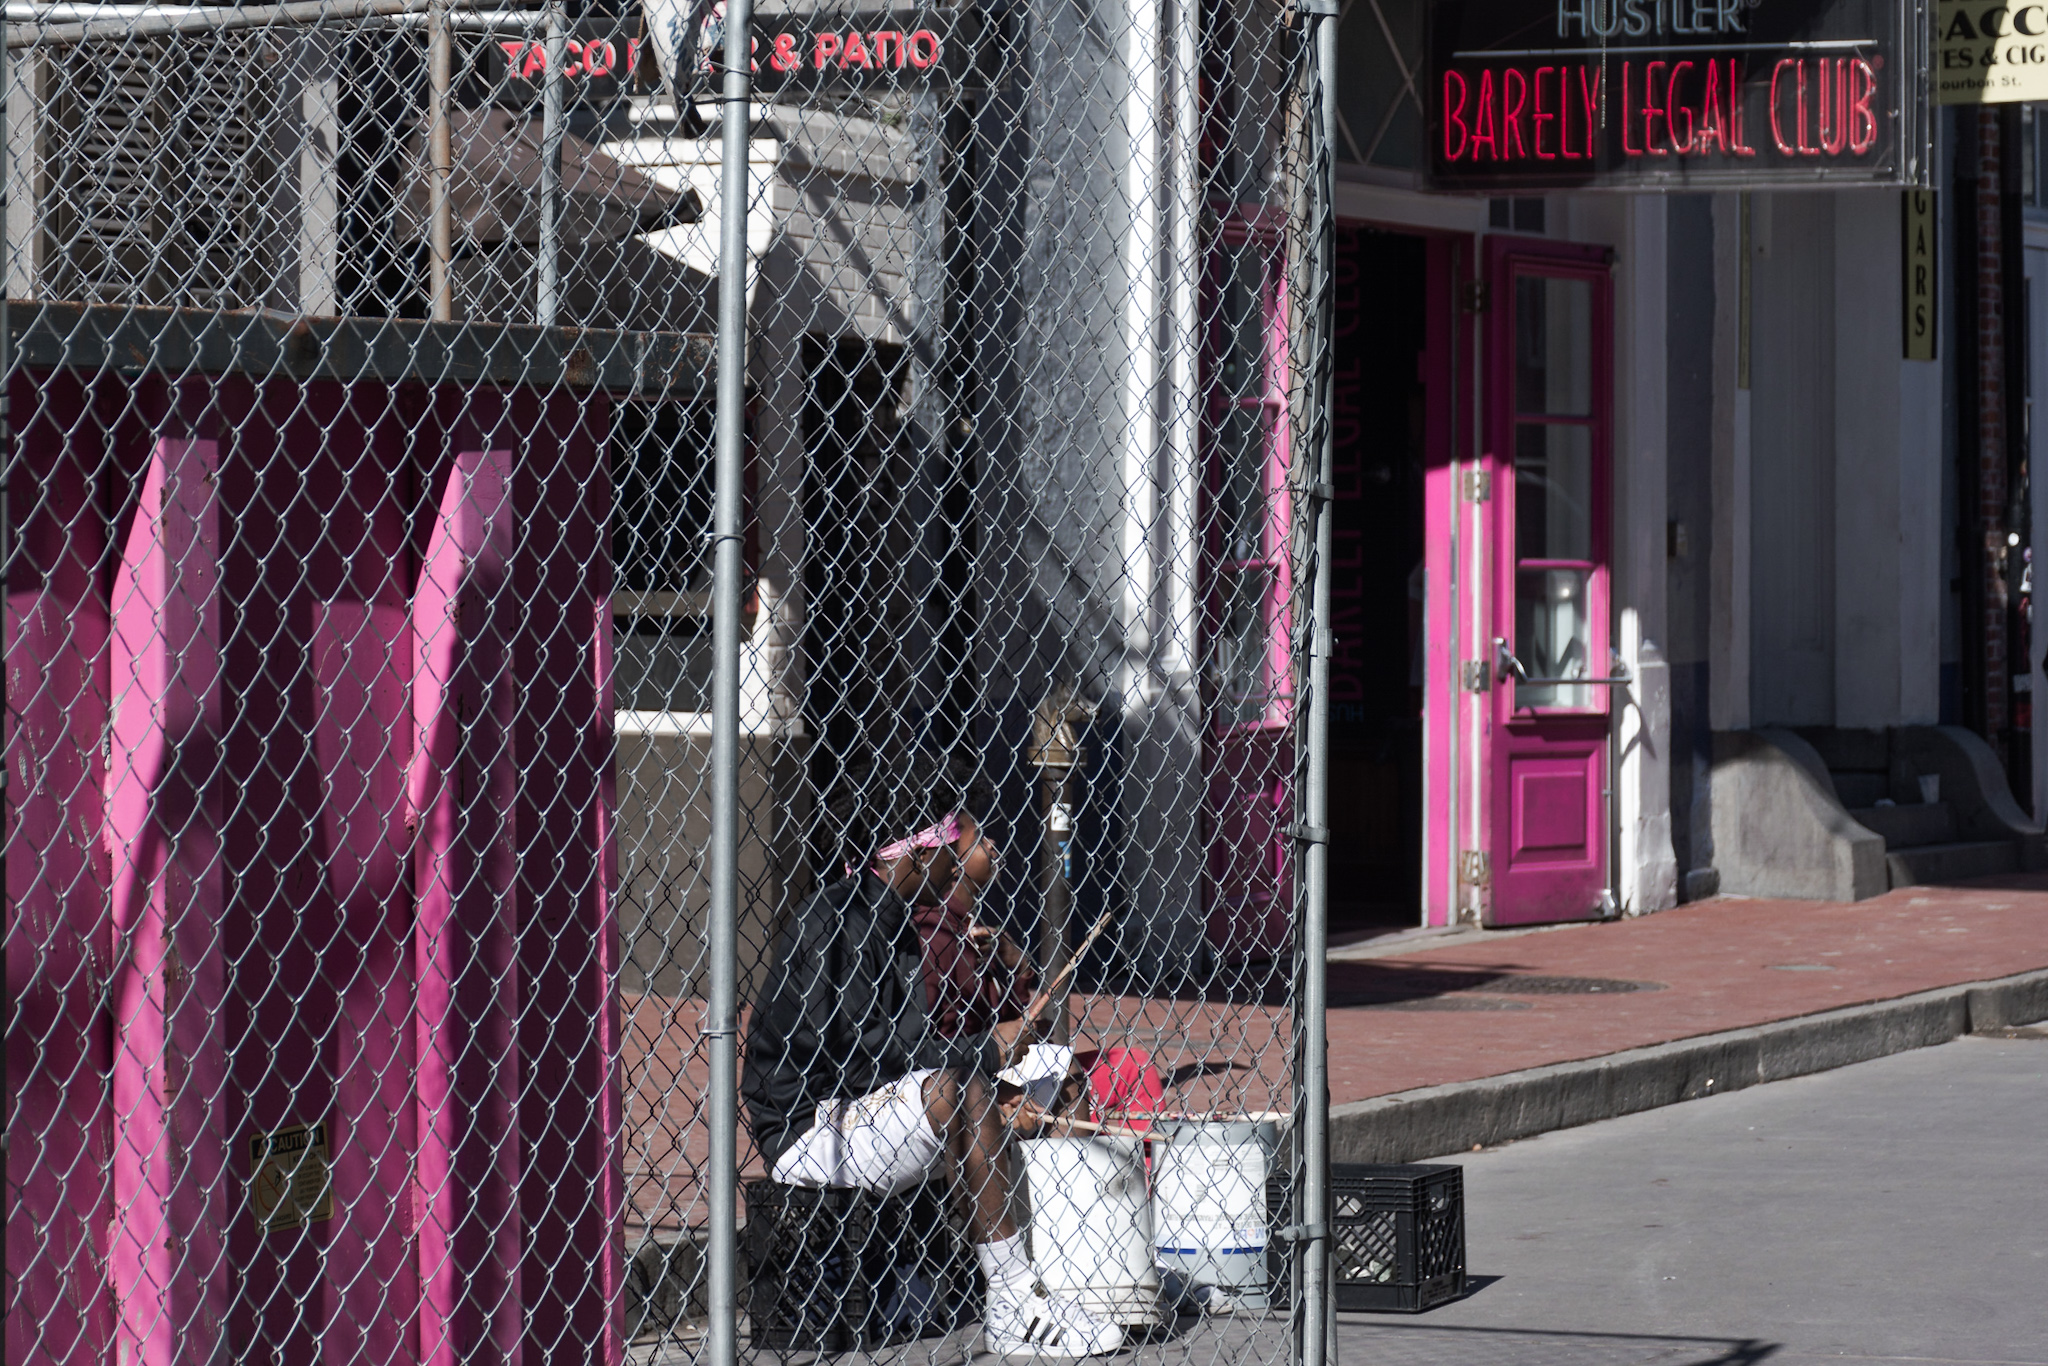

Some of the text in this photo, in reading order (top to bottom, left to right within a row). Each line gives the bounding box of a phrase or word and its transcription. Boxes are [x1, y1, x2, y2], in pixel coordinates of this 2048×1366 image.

[1558, 0, 1748, 38] HUSTLER
[1939, 5, 2048, 41] ACC
[500, 38, 617, 79] TACO
[769, 33, 802, 73] &
[814, 29, 941, 71] PATIO
[1939, 46, 1974, 69] ES
[1980, 45, 1998, 67] &
[1939, 75, 2022, 90] ourbon St.
[1443, 56, 1879, 162] BARELY LEGAL CLUB
[1233, 1228, 1265, 1240] Mob
